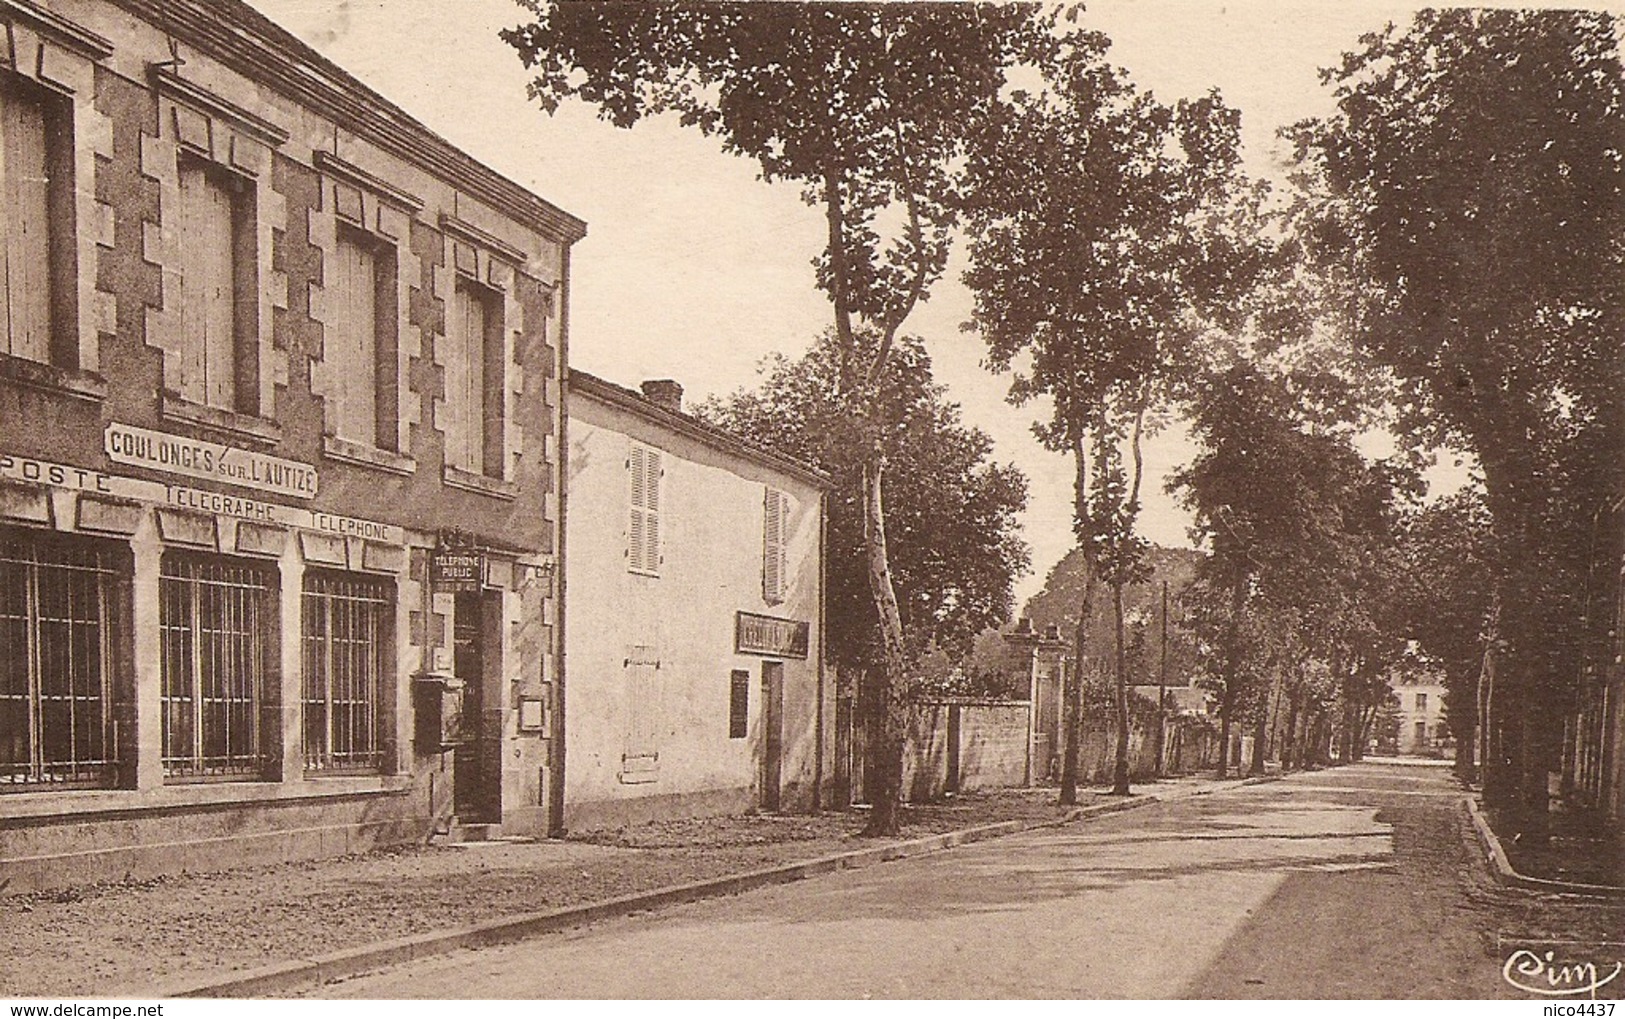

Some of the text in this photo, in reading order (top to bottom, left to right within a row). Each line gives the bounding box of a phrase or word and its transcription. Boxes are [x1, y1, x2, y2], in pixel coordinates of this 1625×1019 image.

[110, 430, 213, 473] COULONGES
[250, 459, 315, 493] L'AUTIZE
[442, 567, 472, 577] PUBLIC
